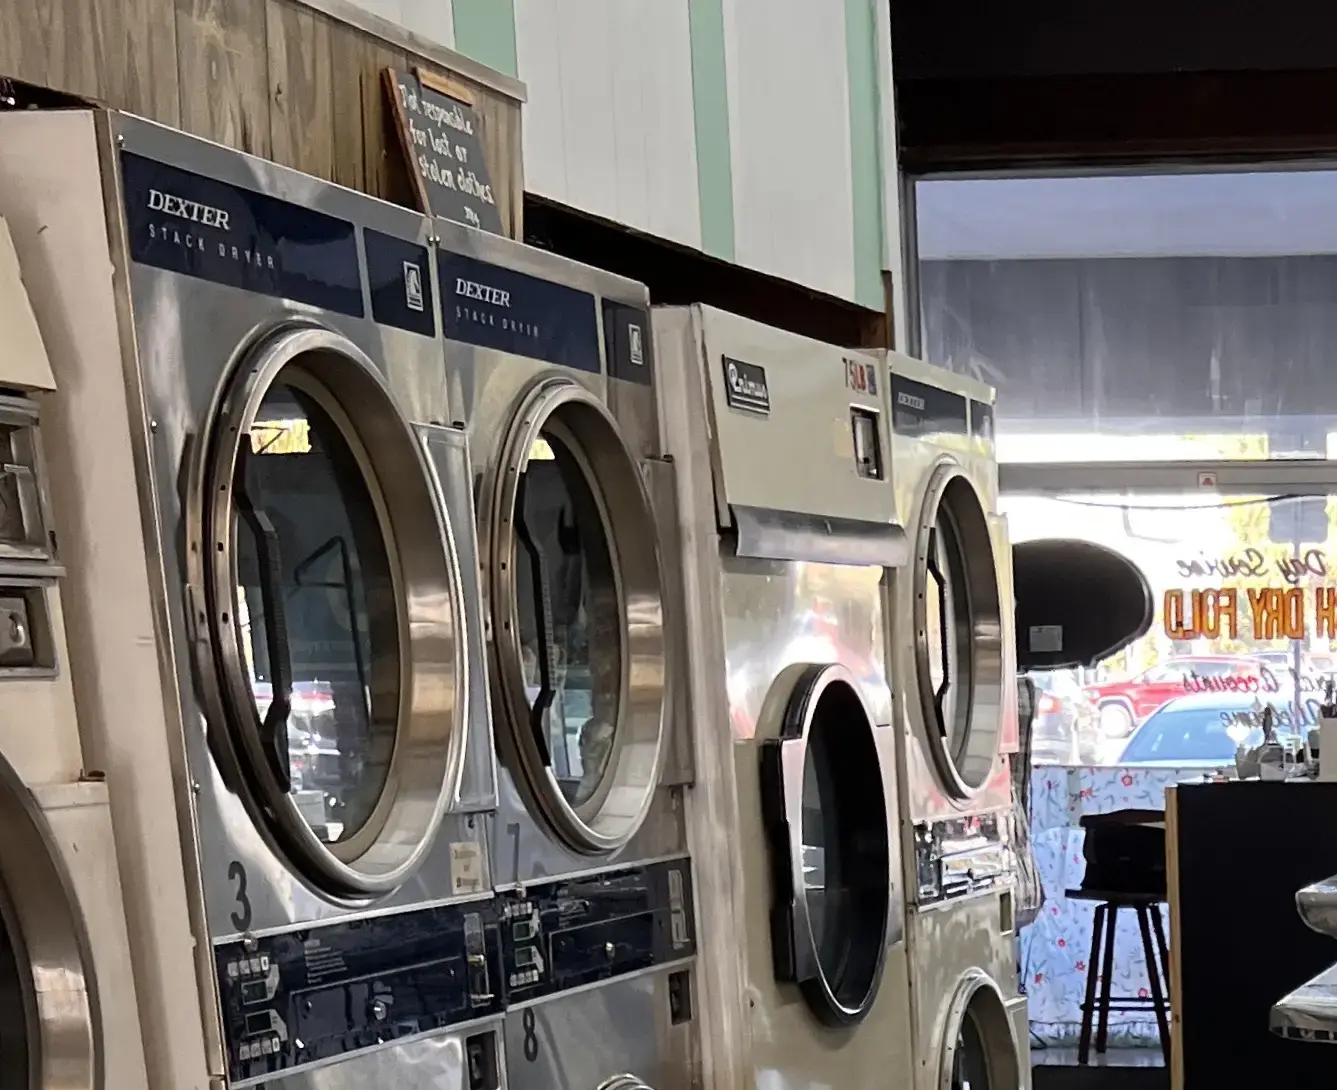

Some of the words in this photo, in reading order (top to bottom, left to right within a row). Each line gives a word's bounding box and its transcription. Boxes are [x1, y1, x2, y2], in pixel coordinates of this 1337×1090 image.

[398, 84, 421, 114] Not
[421, 101, 473, 135] responsible
[409, 118, 427, 147] for
[427, 128, 453, 158] lost
[455, 145, 468, 164] or
[418, 154, 457, 191] stolen
[148, 189, 231, 231] DEXTER
[149, 223, 205, 252] STACK
[219, 243, 275, 269] DRYER
[456, 278, 511, 307] DEXTER
[456, 305, 495, 326] STACK
[502, 317, 540, 338] DRYER
[228, 861, 251, 931] 3
[522, 1007, 538, 1062] 8
